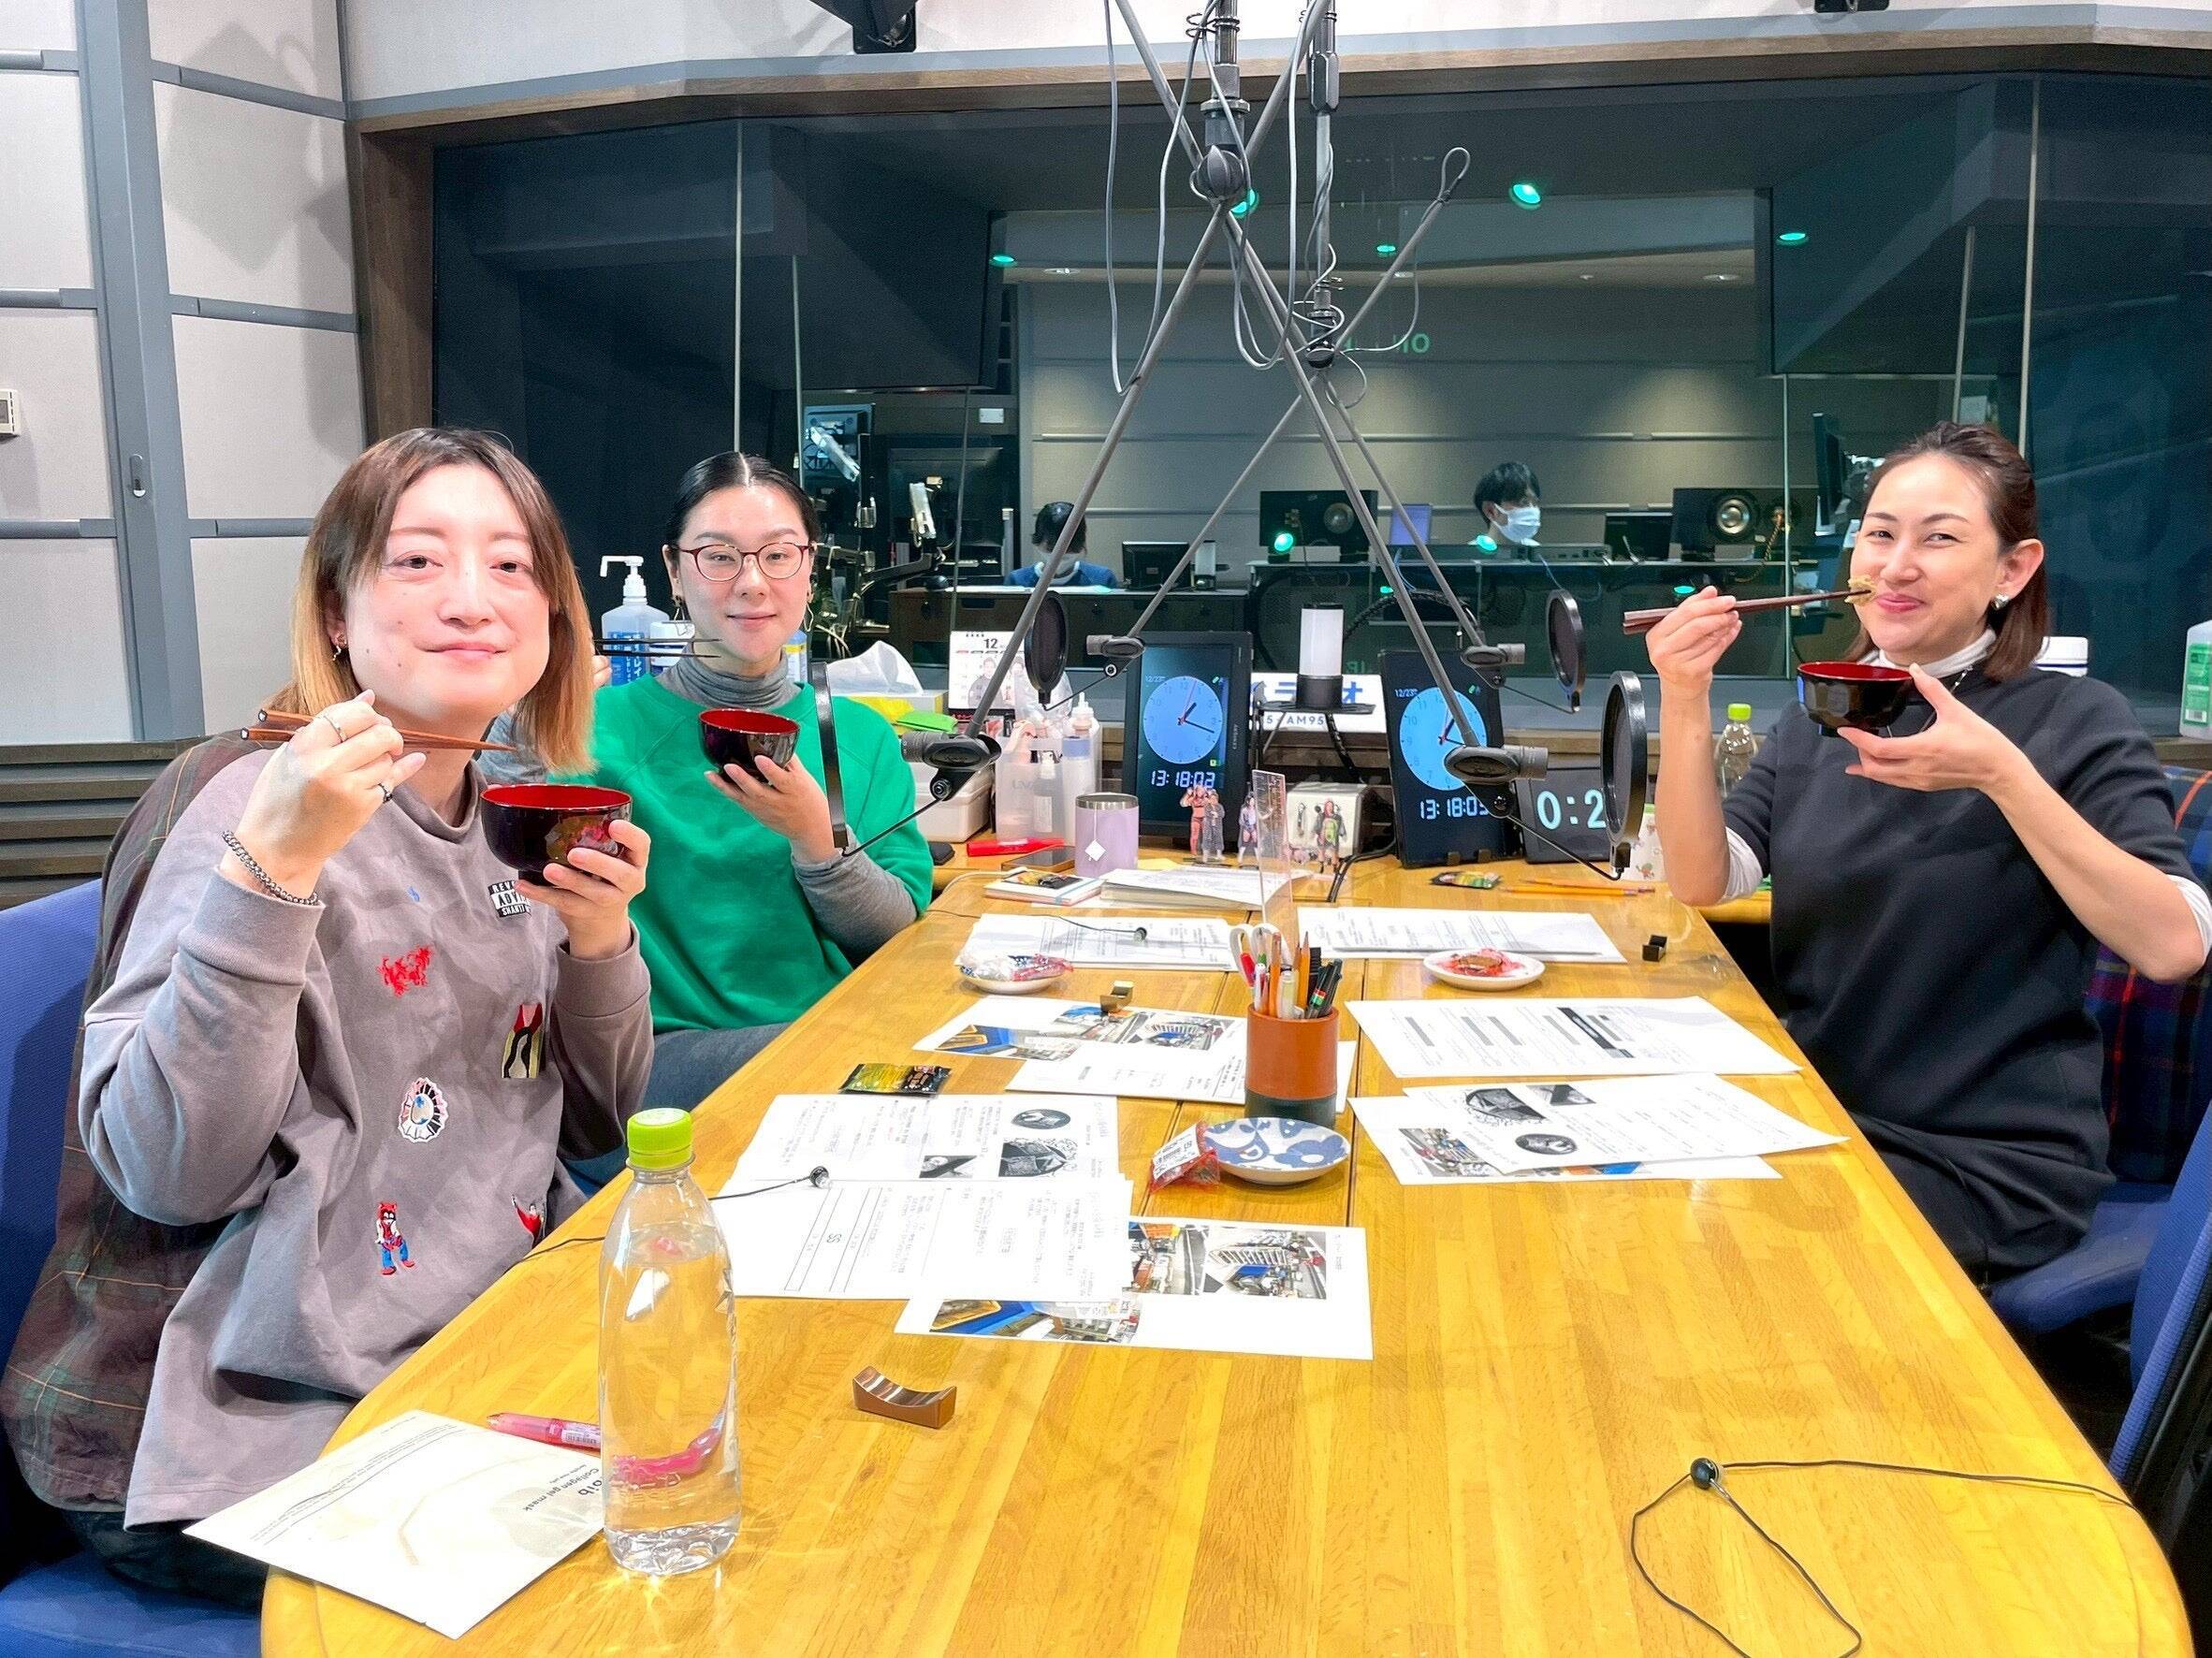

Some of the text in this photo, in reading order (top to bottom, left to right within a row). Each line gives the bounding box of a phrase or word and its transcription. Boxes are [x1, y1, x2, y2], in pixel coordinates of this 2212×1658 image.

[984, 638, 997, 648] 12
[1287, 716, 1325, 725] AM95
[1537, 789, 1607, 829] 0:2
[561, 1468, 599, 1489] Collagen
[546, 1486, 561, 1496] gel
[523, 1495, 546, 1511] mask
